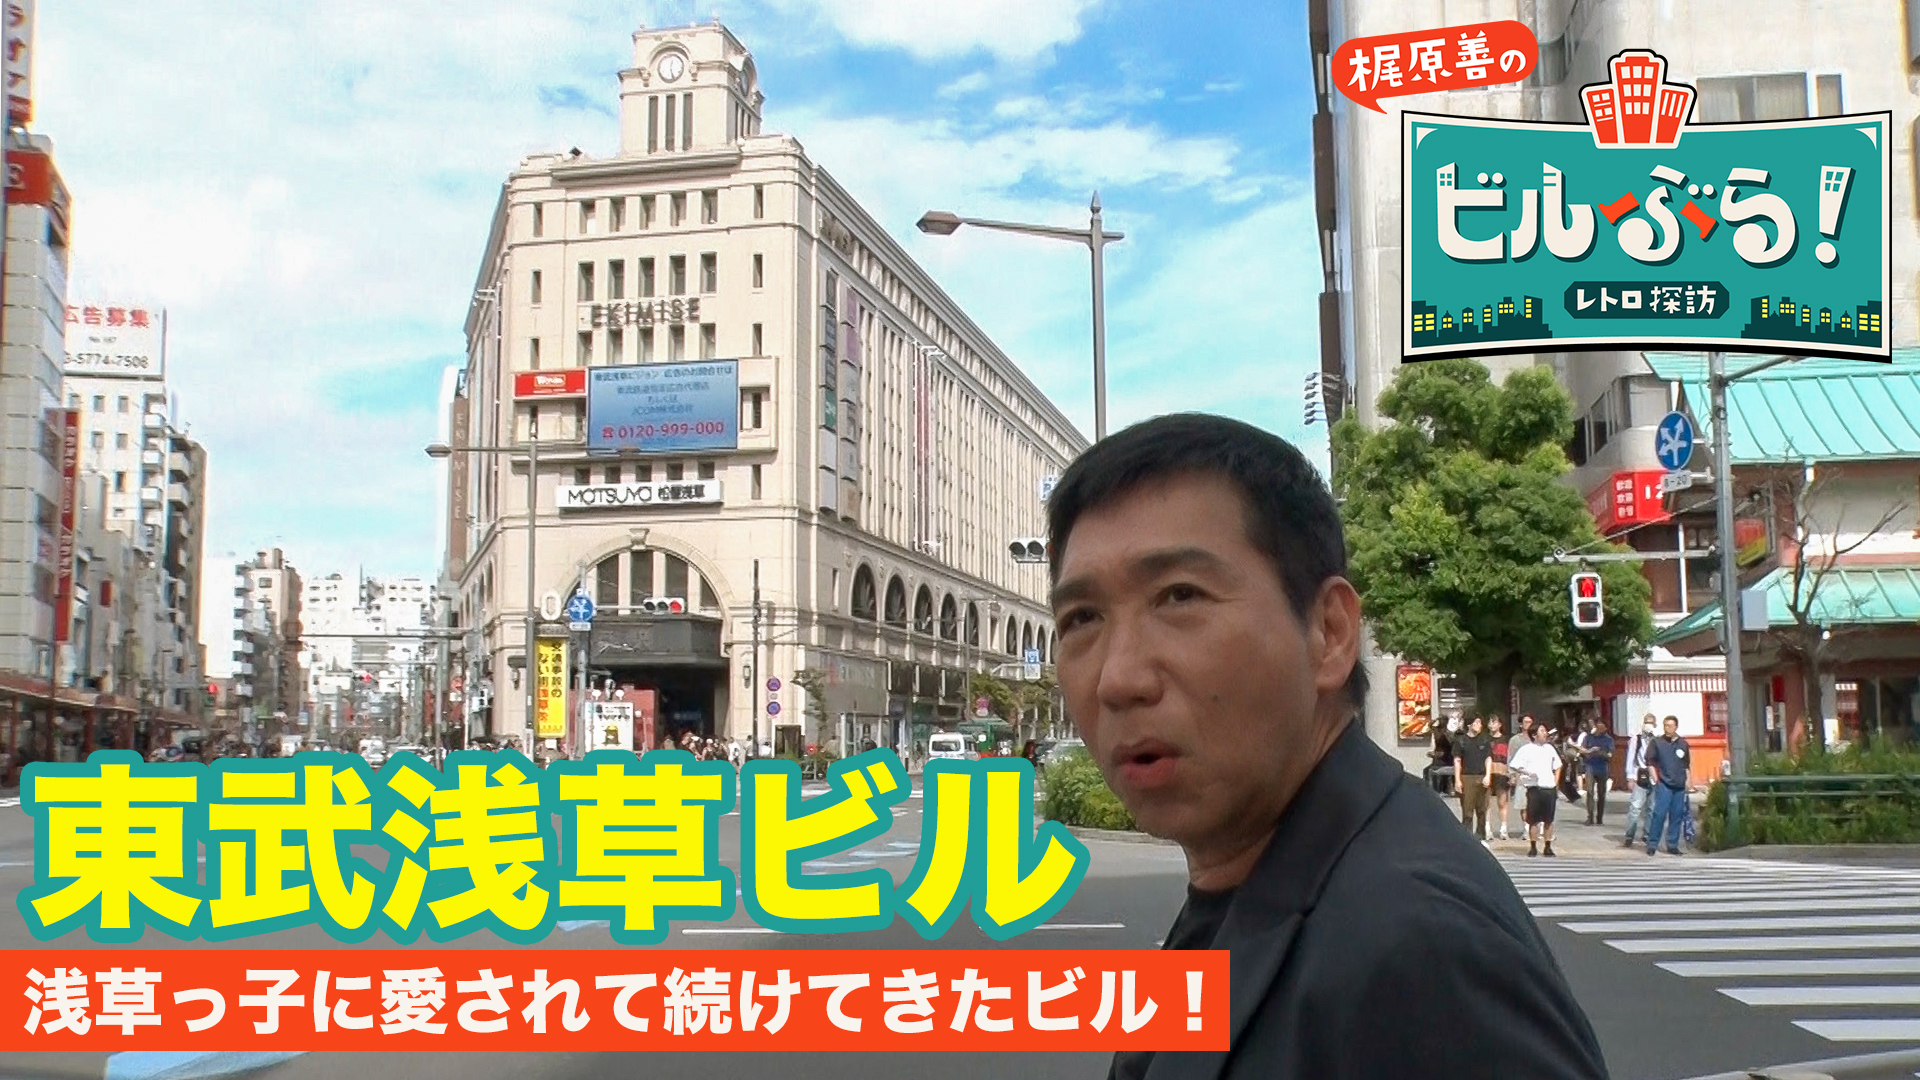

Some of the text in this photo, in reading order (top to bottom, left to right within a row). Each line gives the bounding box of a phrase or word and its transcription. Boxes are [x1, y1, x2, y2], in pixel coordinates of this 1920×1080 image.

[591, 298, 700, 328] EKIMISE
[618, 421, 725, 439] 0120-999-000
[551, 641, 563, 698] 交通事故の
